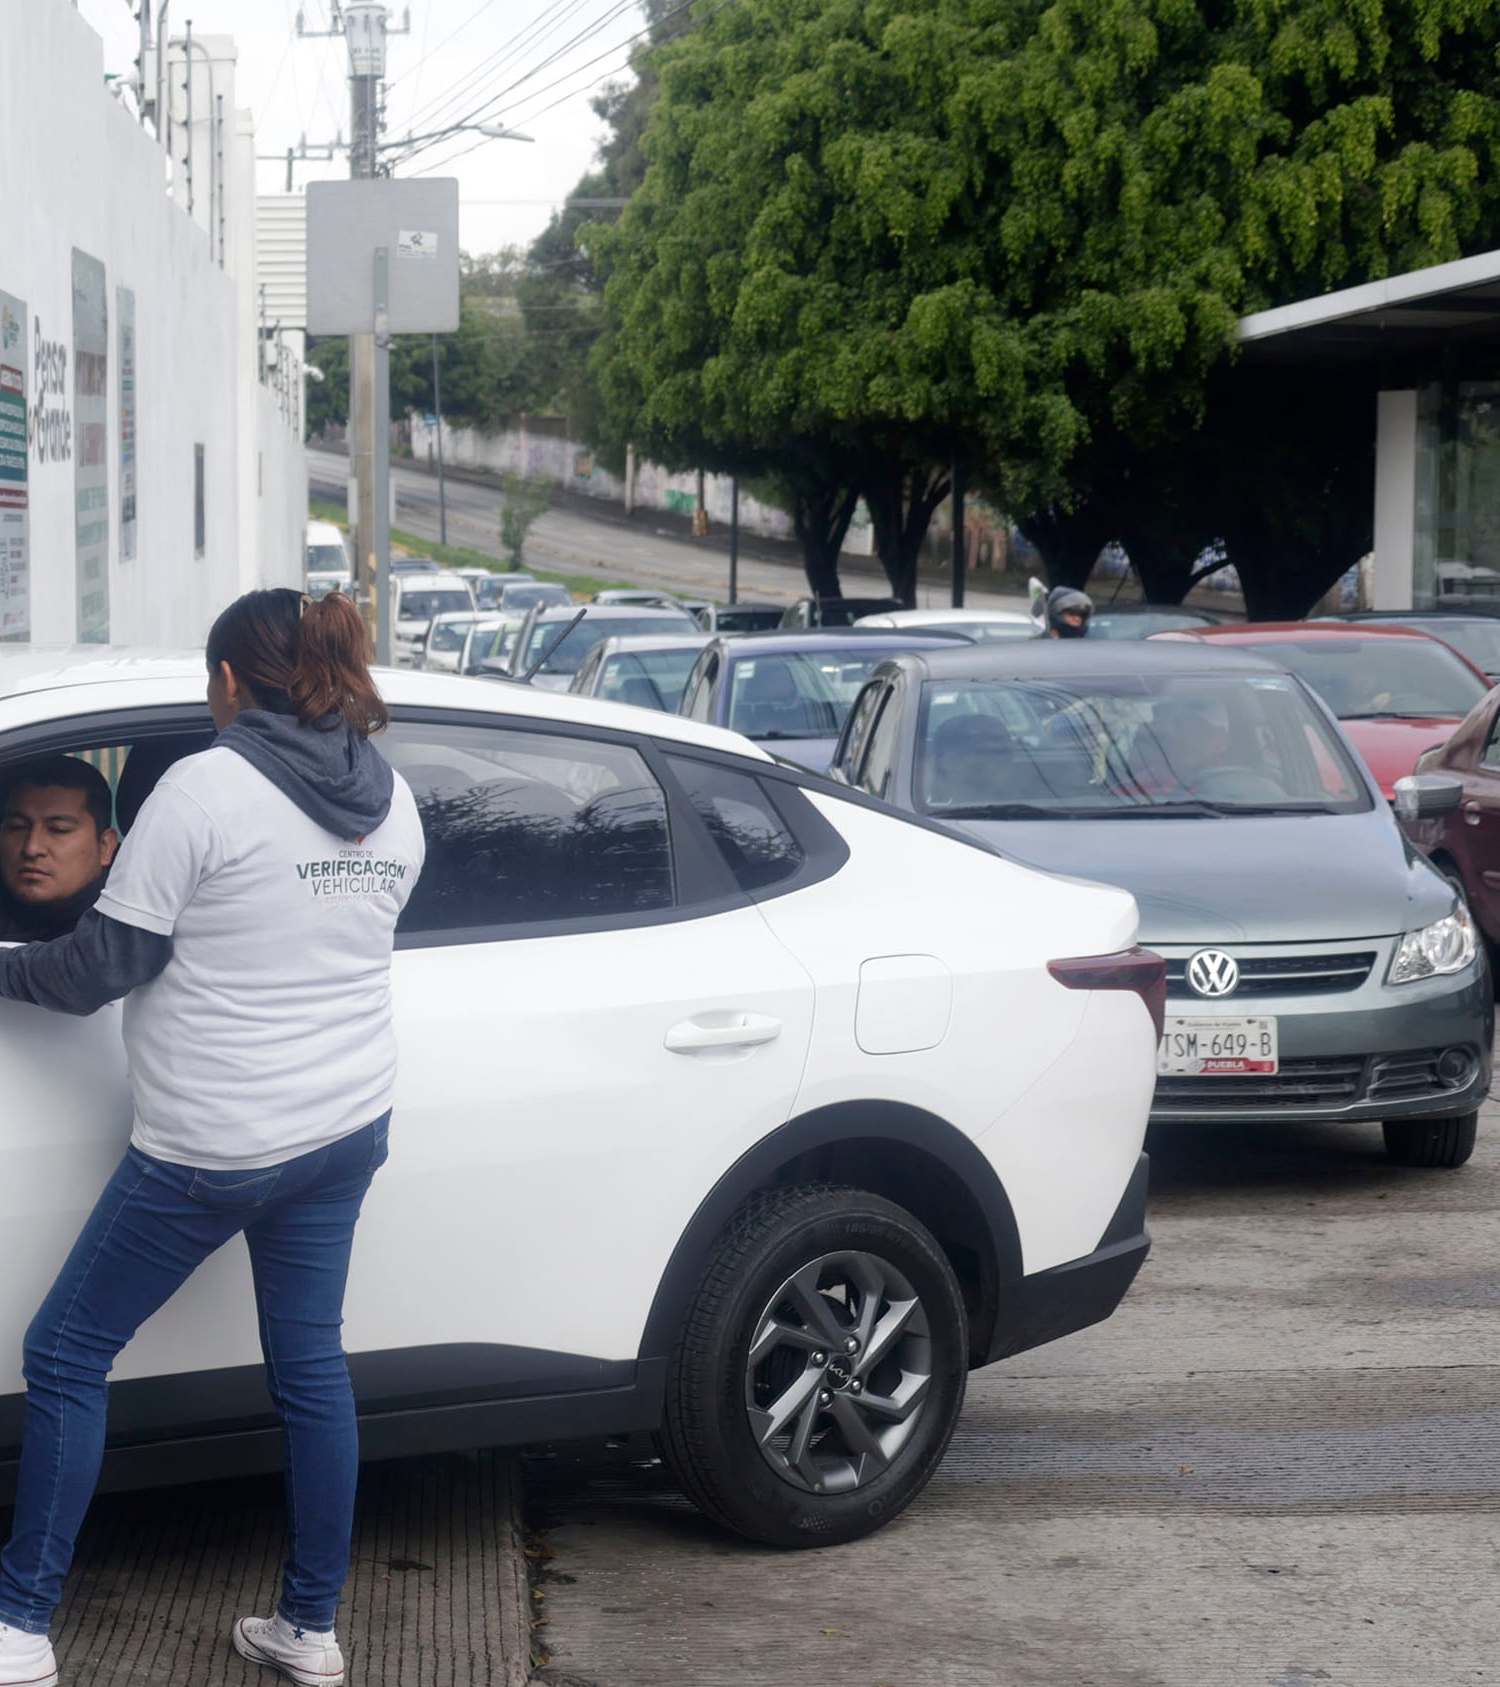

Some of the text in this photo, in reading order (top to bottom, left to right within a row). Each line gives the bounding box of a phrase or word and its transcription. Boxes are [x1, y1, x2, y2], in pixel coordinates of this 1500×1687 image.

[339, 850, 365, 858] CENTRO
[296, 860, 407, 880] VERIFICACIÓN
[312, 877, 396, 896] VEHICULAR
[1163, 1032, 1272, 1057] TSM-649-B
[1205, 1060, 1245, 1072] PUEBLA
